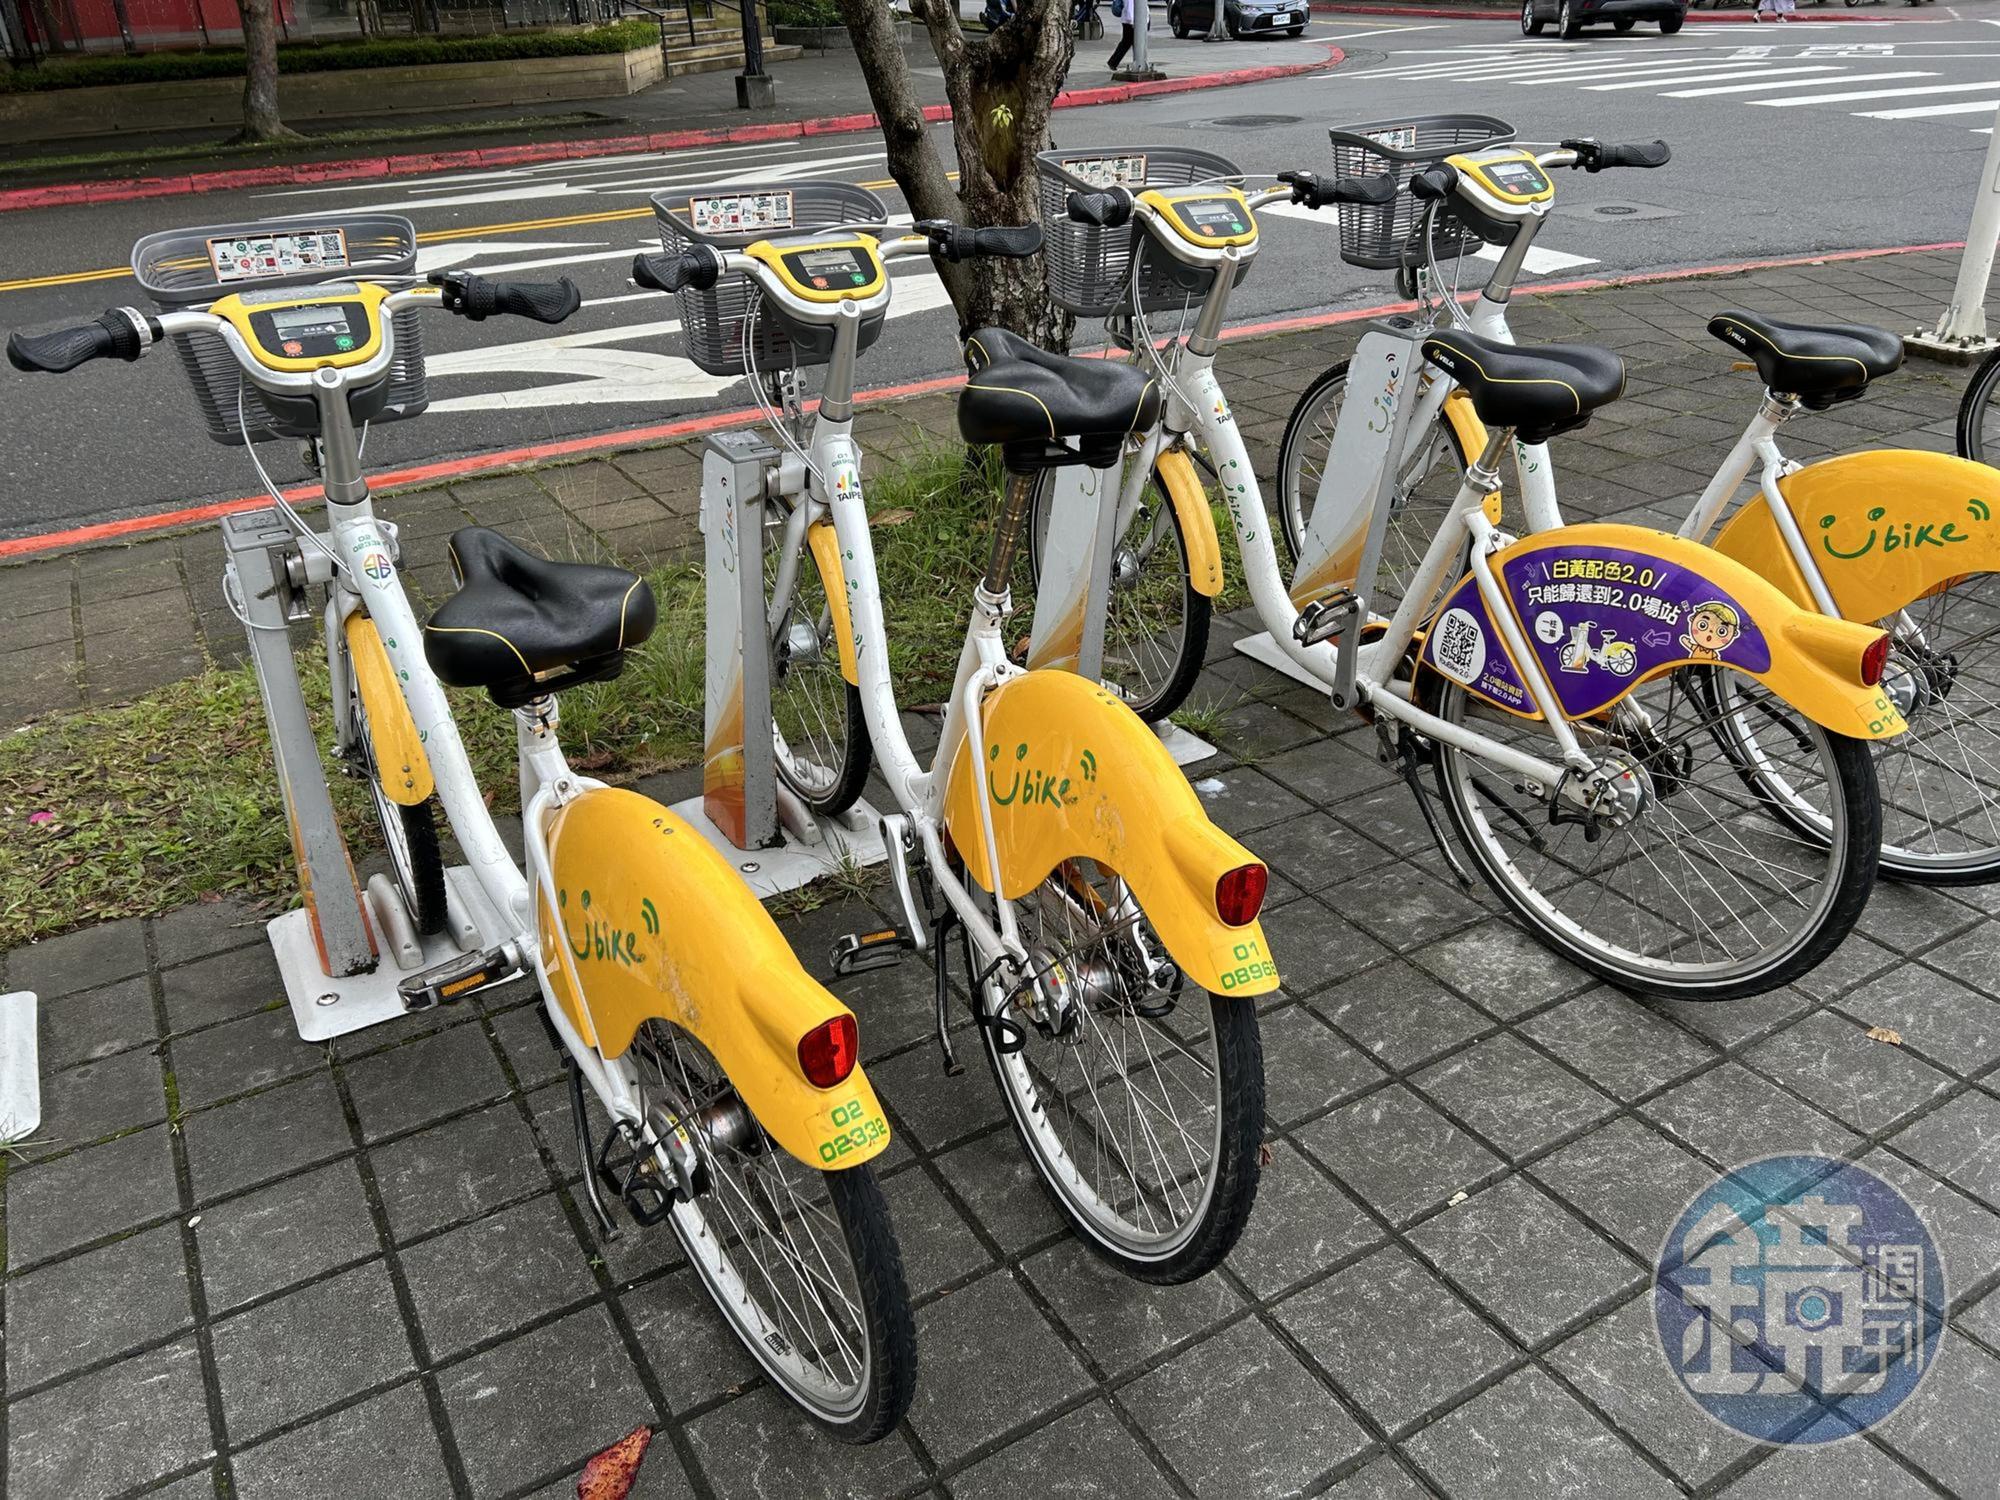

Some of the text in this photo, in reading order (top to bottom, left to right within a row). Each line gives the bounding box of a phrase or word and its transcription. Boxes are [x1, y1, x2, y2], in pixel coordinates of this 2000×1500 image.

[1528, 583, 1682, 625] 只能歸還到2.0場站
[1233, 941, 1260, 961] 01
[831, 1100, 864, 1128] 02
[819, 1117, 887, 1163] 02332
